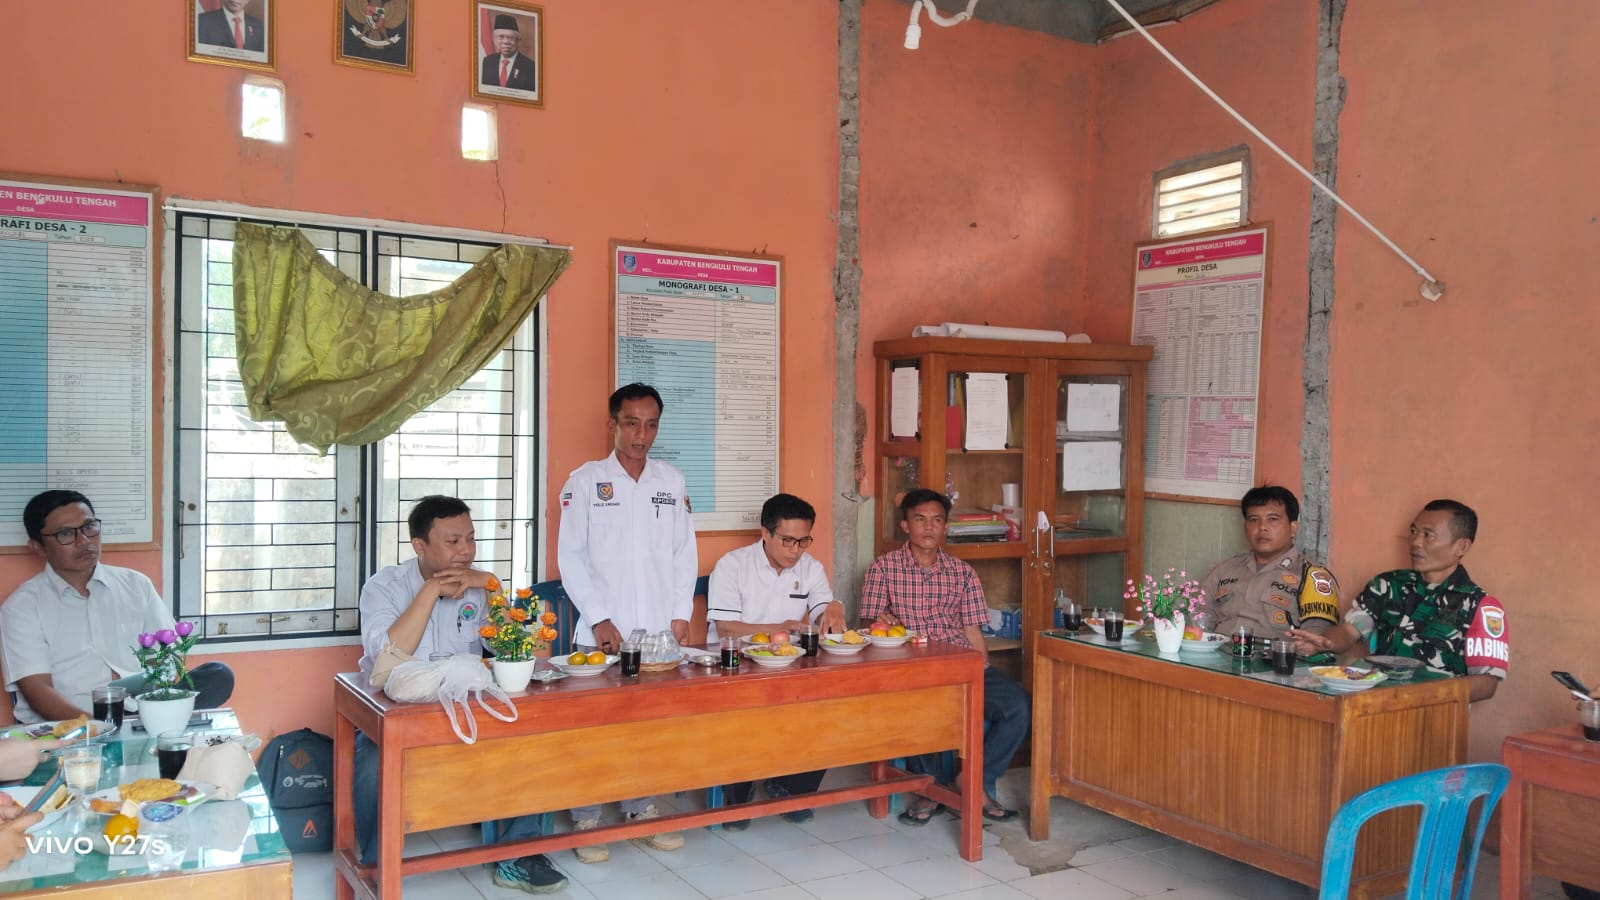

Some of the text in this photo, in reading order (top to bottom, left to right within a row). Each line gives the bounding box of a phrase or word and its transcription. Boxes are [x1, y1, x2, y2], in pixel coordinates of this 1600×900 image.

[16, 192, 72, 204] BENGKULU
[75, 197, 117, 207] TENGAH
[0, 219, 31, 229] RAFI
[34, 222, 67, 232] DESA
[79, 225, 87, 233] 2
[1165, 238, 1247, 256] KABUPATEN BENGKULU TENGAH
[657, 258, 696, 268] KABUPATEN
[697, 262, 731, 271] BENGKULU
[1177, 263, 1218, 274] PROFIL DESA
[658, 280, 706, 291] MONOGRAFI
[708, 284, 728, 293] DESA
[1271, 581, 1298, 596] POLR
[1466, 637, 1509, 662] BABINS
